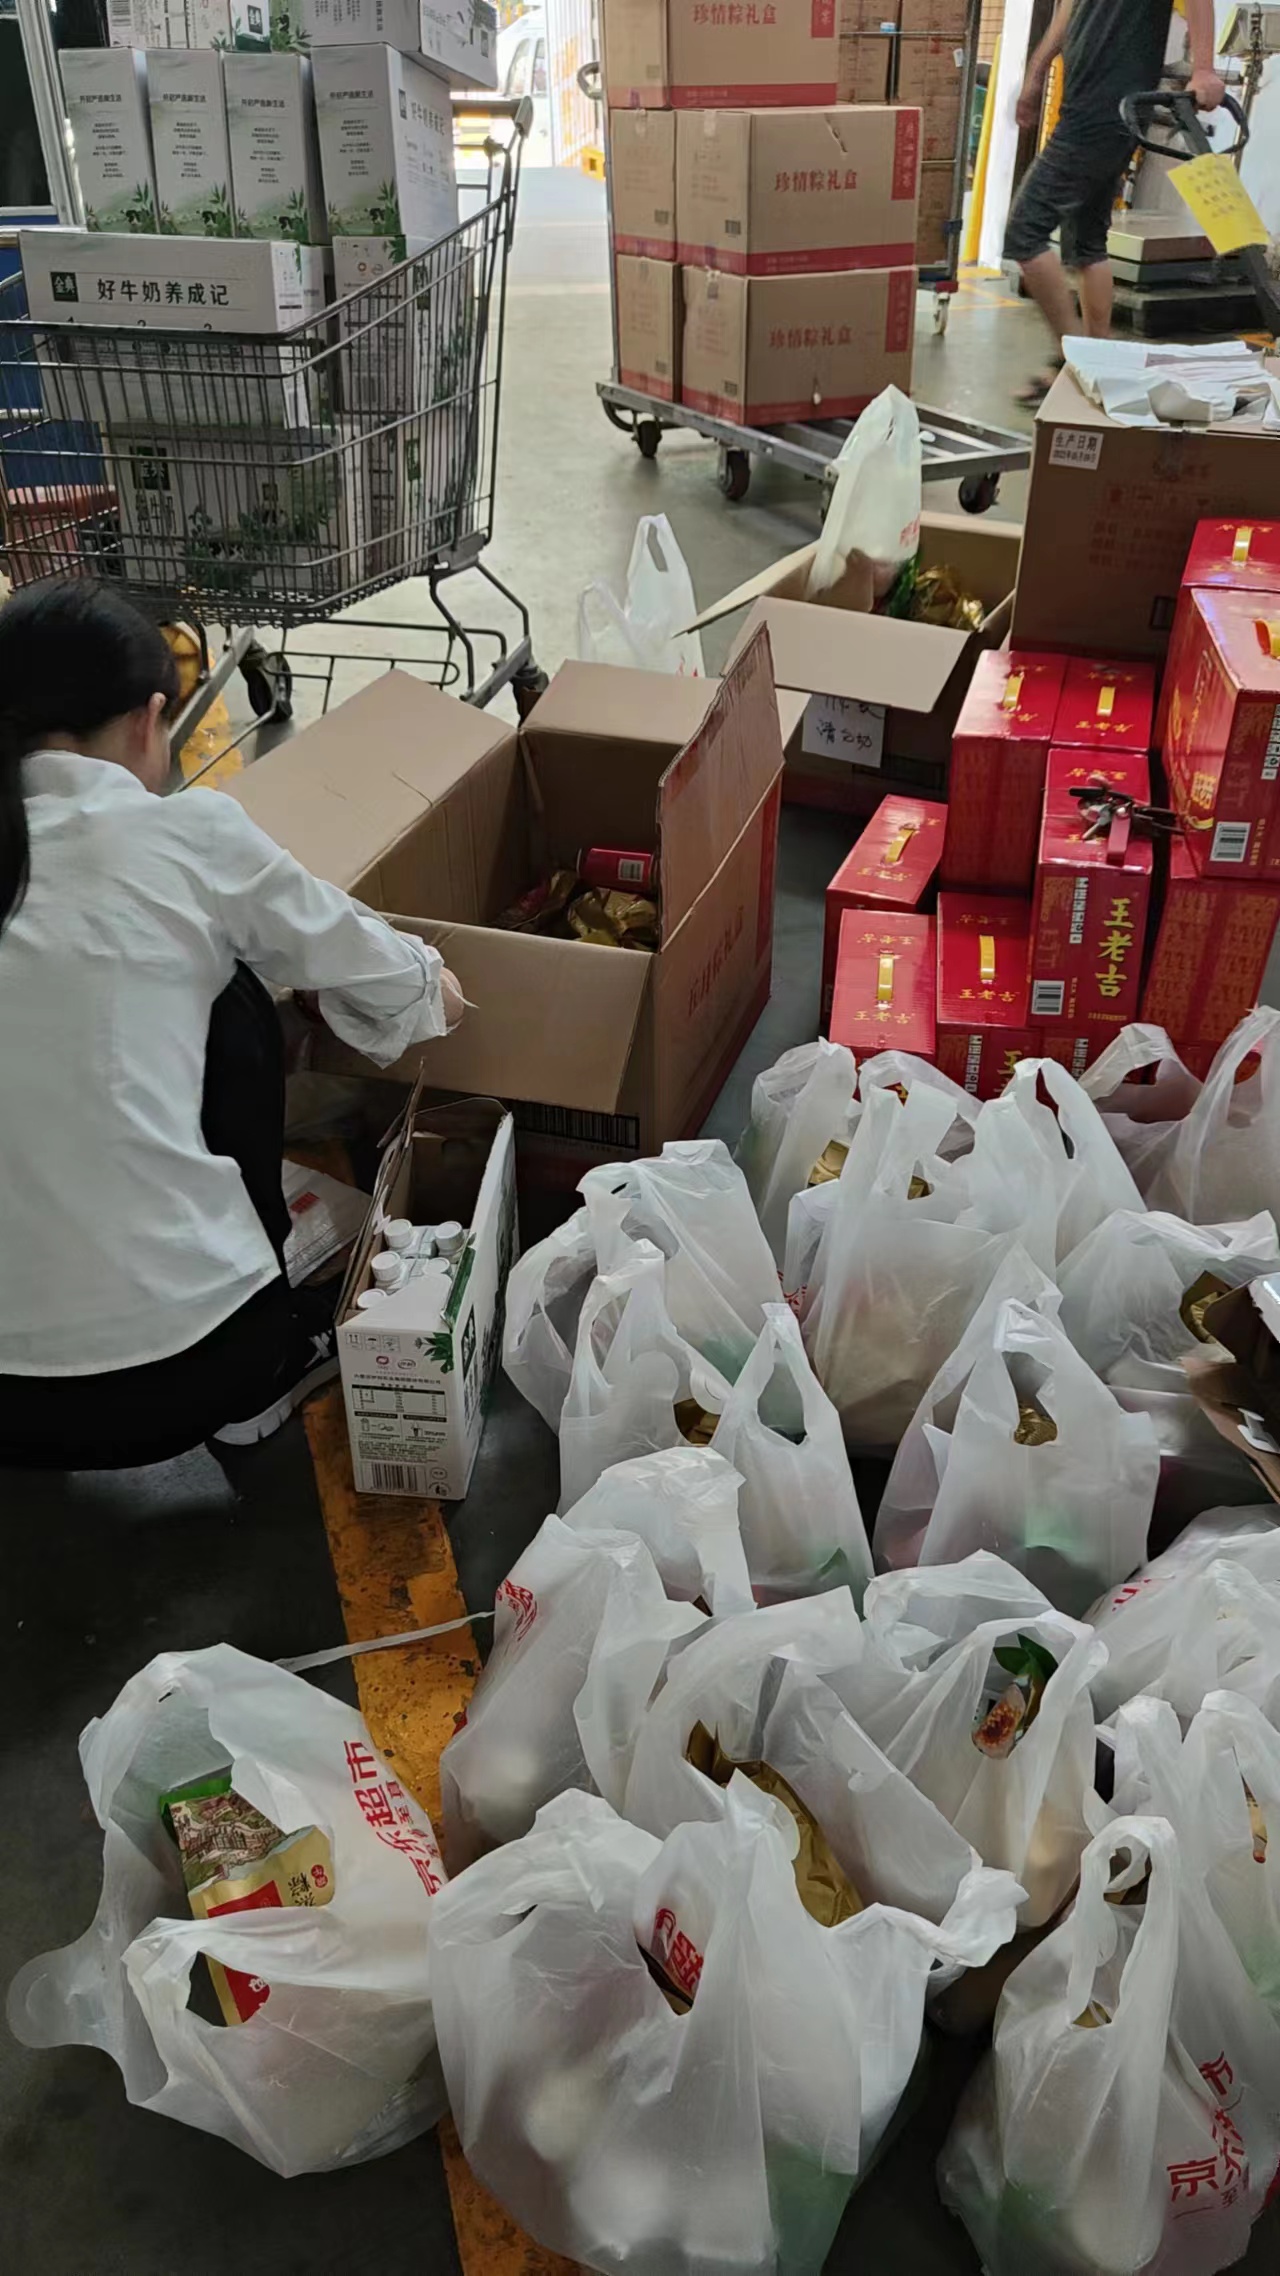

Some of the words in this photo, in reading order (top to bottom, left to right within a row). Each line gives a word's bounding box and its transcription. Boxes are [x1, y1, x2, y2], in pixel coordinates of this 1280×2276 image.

[774, 169, 858, 193] 珍情粽礼盒
[97, 278, 229, 307] 好牛奶养成记
[1055, 431, 1098, 452] 生产日期
[1095, 897, 1135, 998] 王老吉
[958, 988, 1021, 1002] 王老吉
[853, 1010, 916, 1025] 王老吉
[343, 1740, 443, 1897] 京东超市
